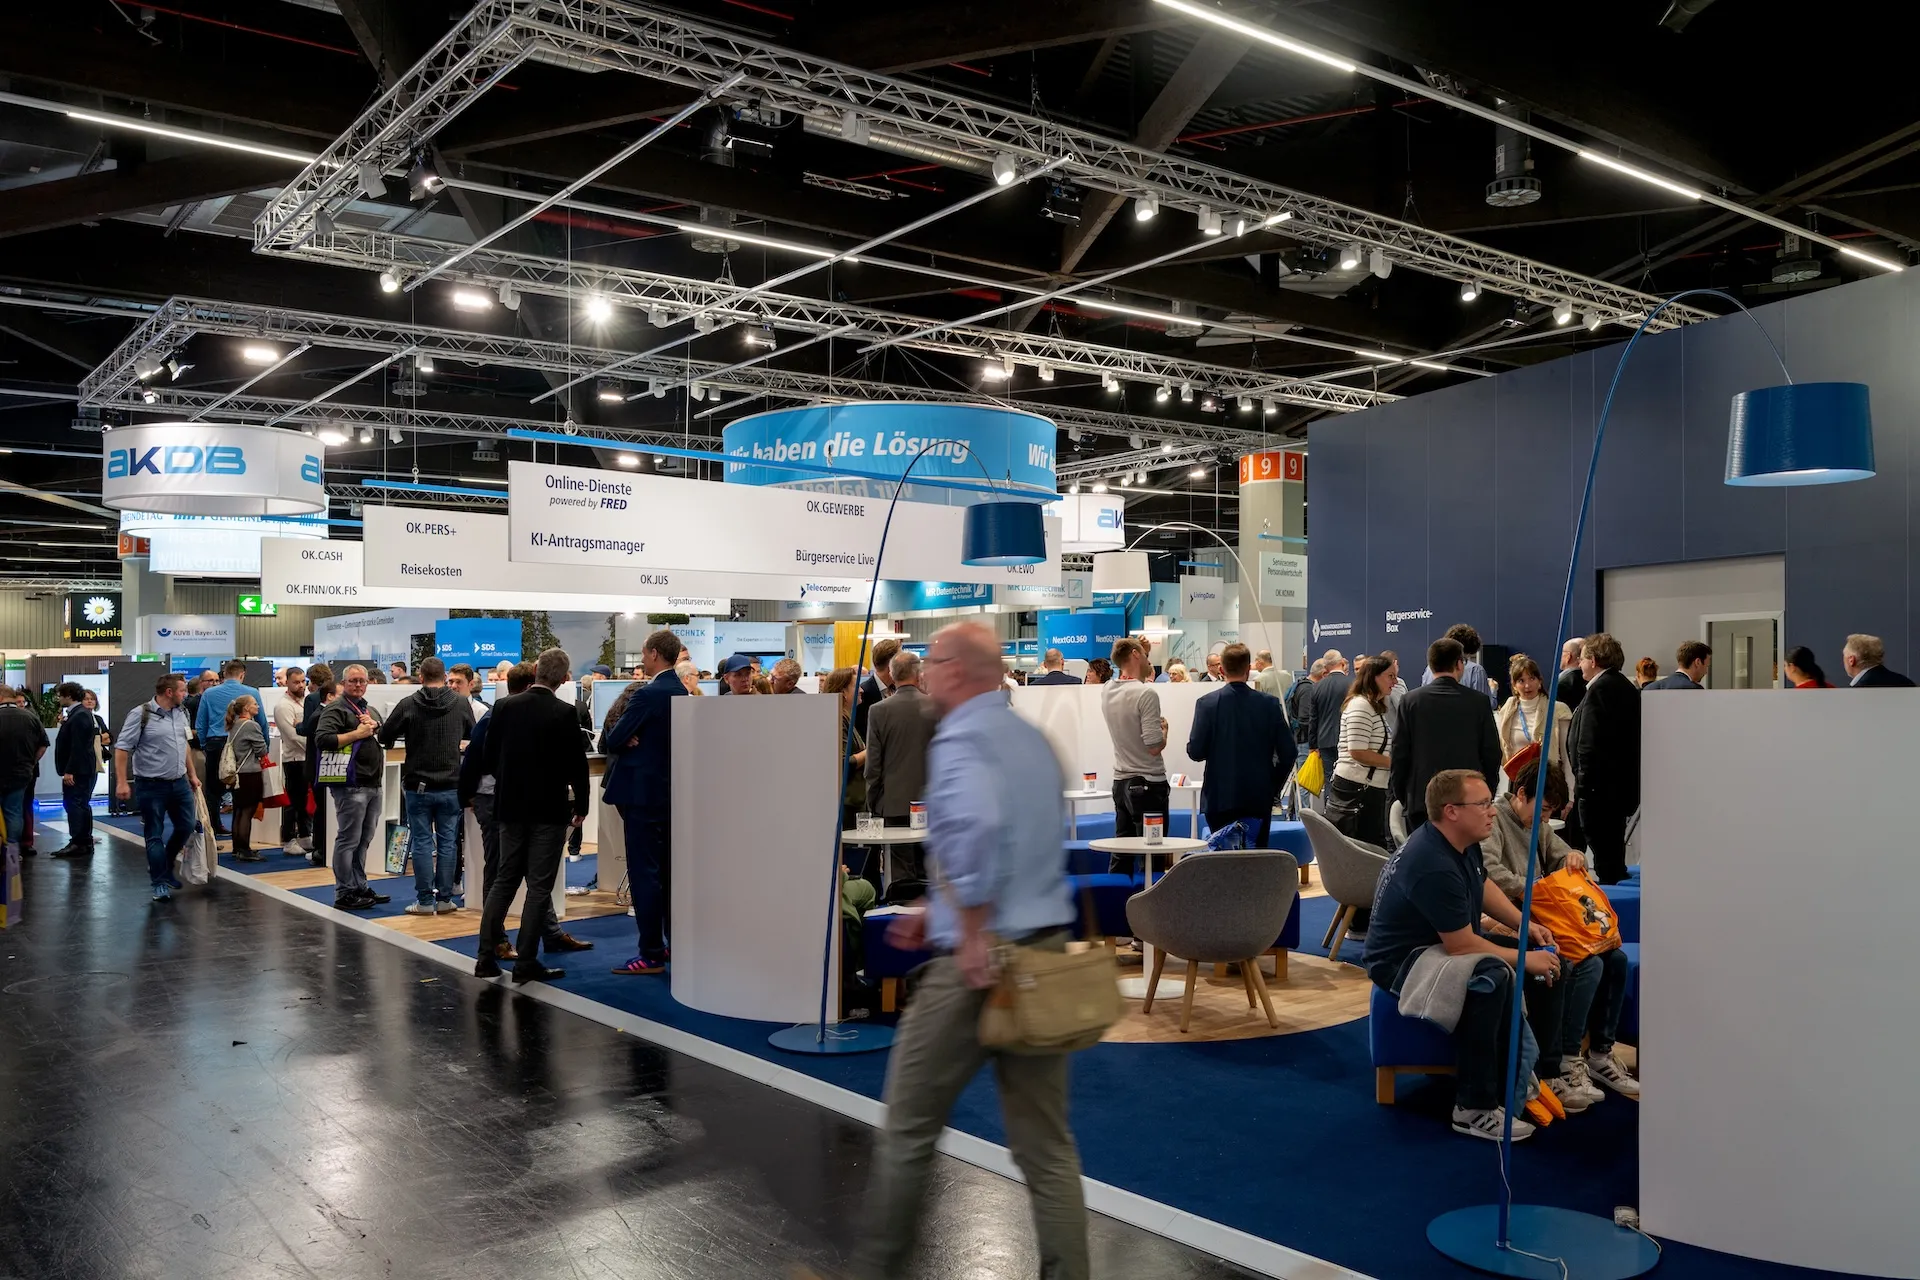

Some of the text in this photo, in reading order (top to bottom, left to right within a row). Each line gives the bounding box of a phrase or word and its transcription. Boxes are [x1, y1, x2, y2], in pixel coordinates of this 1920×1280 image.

[753, 438, 817, 464] haben
[823, 431, 865, 458] die
[873, 431, 970, 464] Lösung
[1028, 443, 1049, 468] Wir
[1242, 461, 1248, 479] 9
[1260, 457, 1272, 476] 9
[1289, 457, 1298, 476] 9
[545, 474, 633, 496] Online-Dienste
[549, 496, 628, 510] powered by FRED
[806, 499, 865, 516] OK.GEWERBE
[406, 521, 457, 536] OK.PERS+
[123, 536, 130, 550] 9
[530, 532, 646, 555] KI-Antragsmanager
[301, 549, 343, 562] OK.CASH
[795, 549, 875, 567] Bürgerservice Live
[400, 563, 463, 577] Reisekosten
[640, 574, 669, 586] OK.JUS
[286, 583, 358, 596] OK.FINN/OK.FIS
[806, 583, 852, 594] Telecomputer
[925, 584, 973, 597] MR Datentechnik
[667, 596, 716, 607] Signaturservice
[1193, 591, 1216, 600] LivingData
[1385, 608, 1433, 623] Bürgerservice-
[75, 627, 124, 640] Implenia
[1385, 622, 1399, 633] Box
[1052, 634, 1088, 645] NextGO.360
[442, 644, 453, 652] SDS
[481, 643, 496, 651] SDS
[320, 753, 351, 765] ZUM
[319, 764, 348, 777] BIKE
